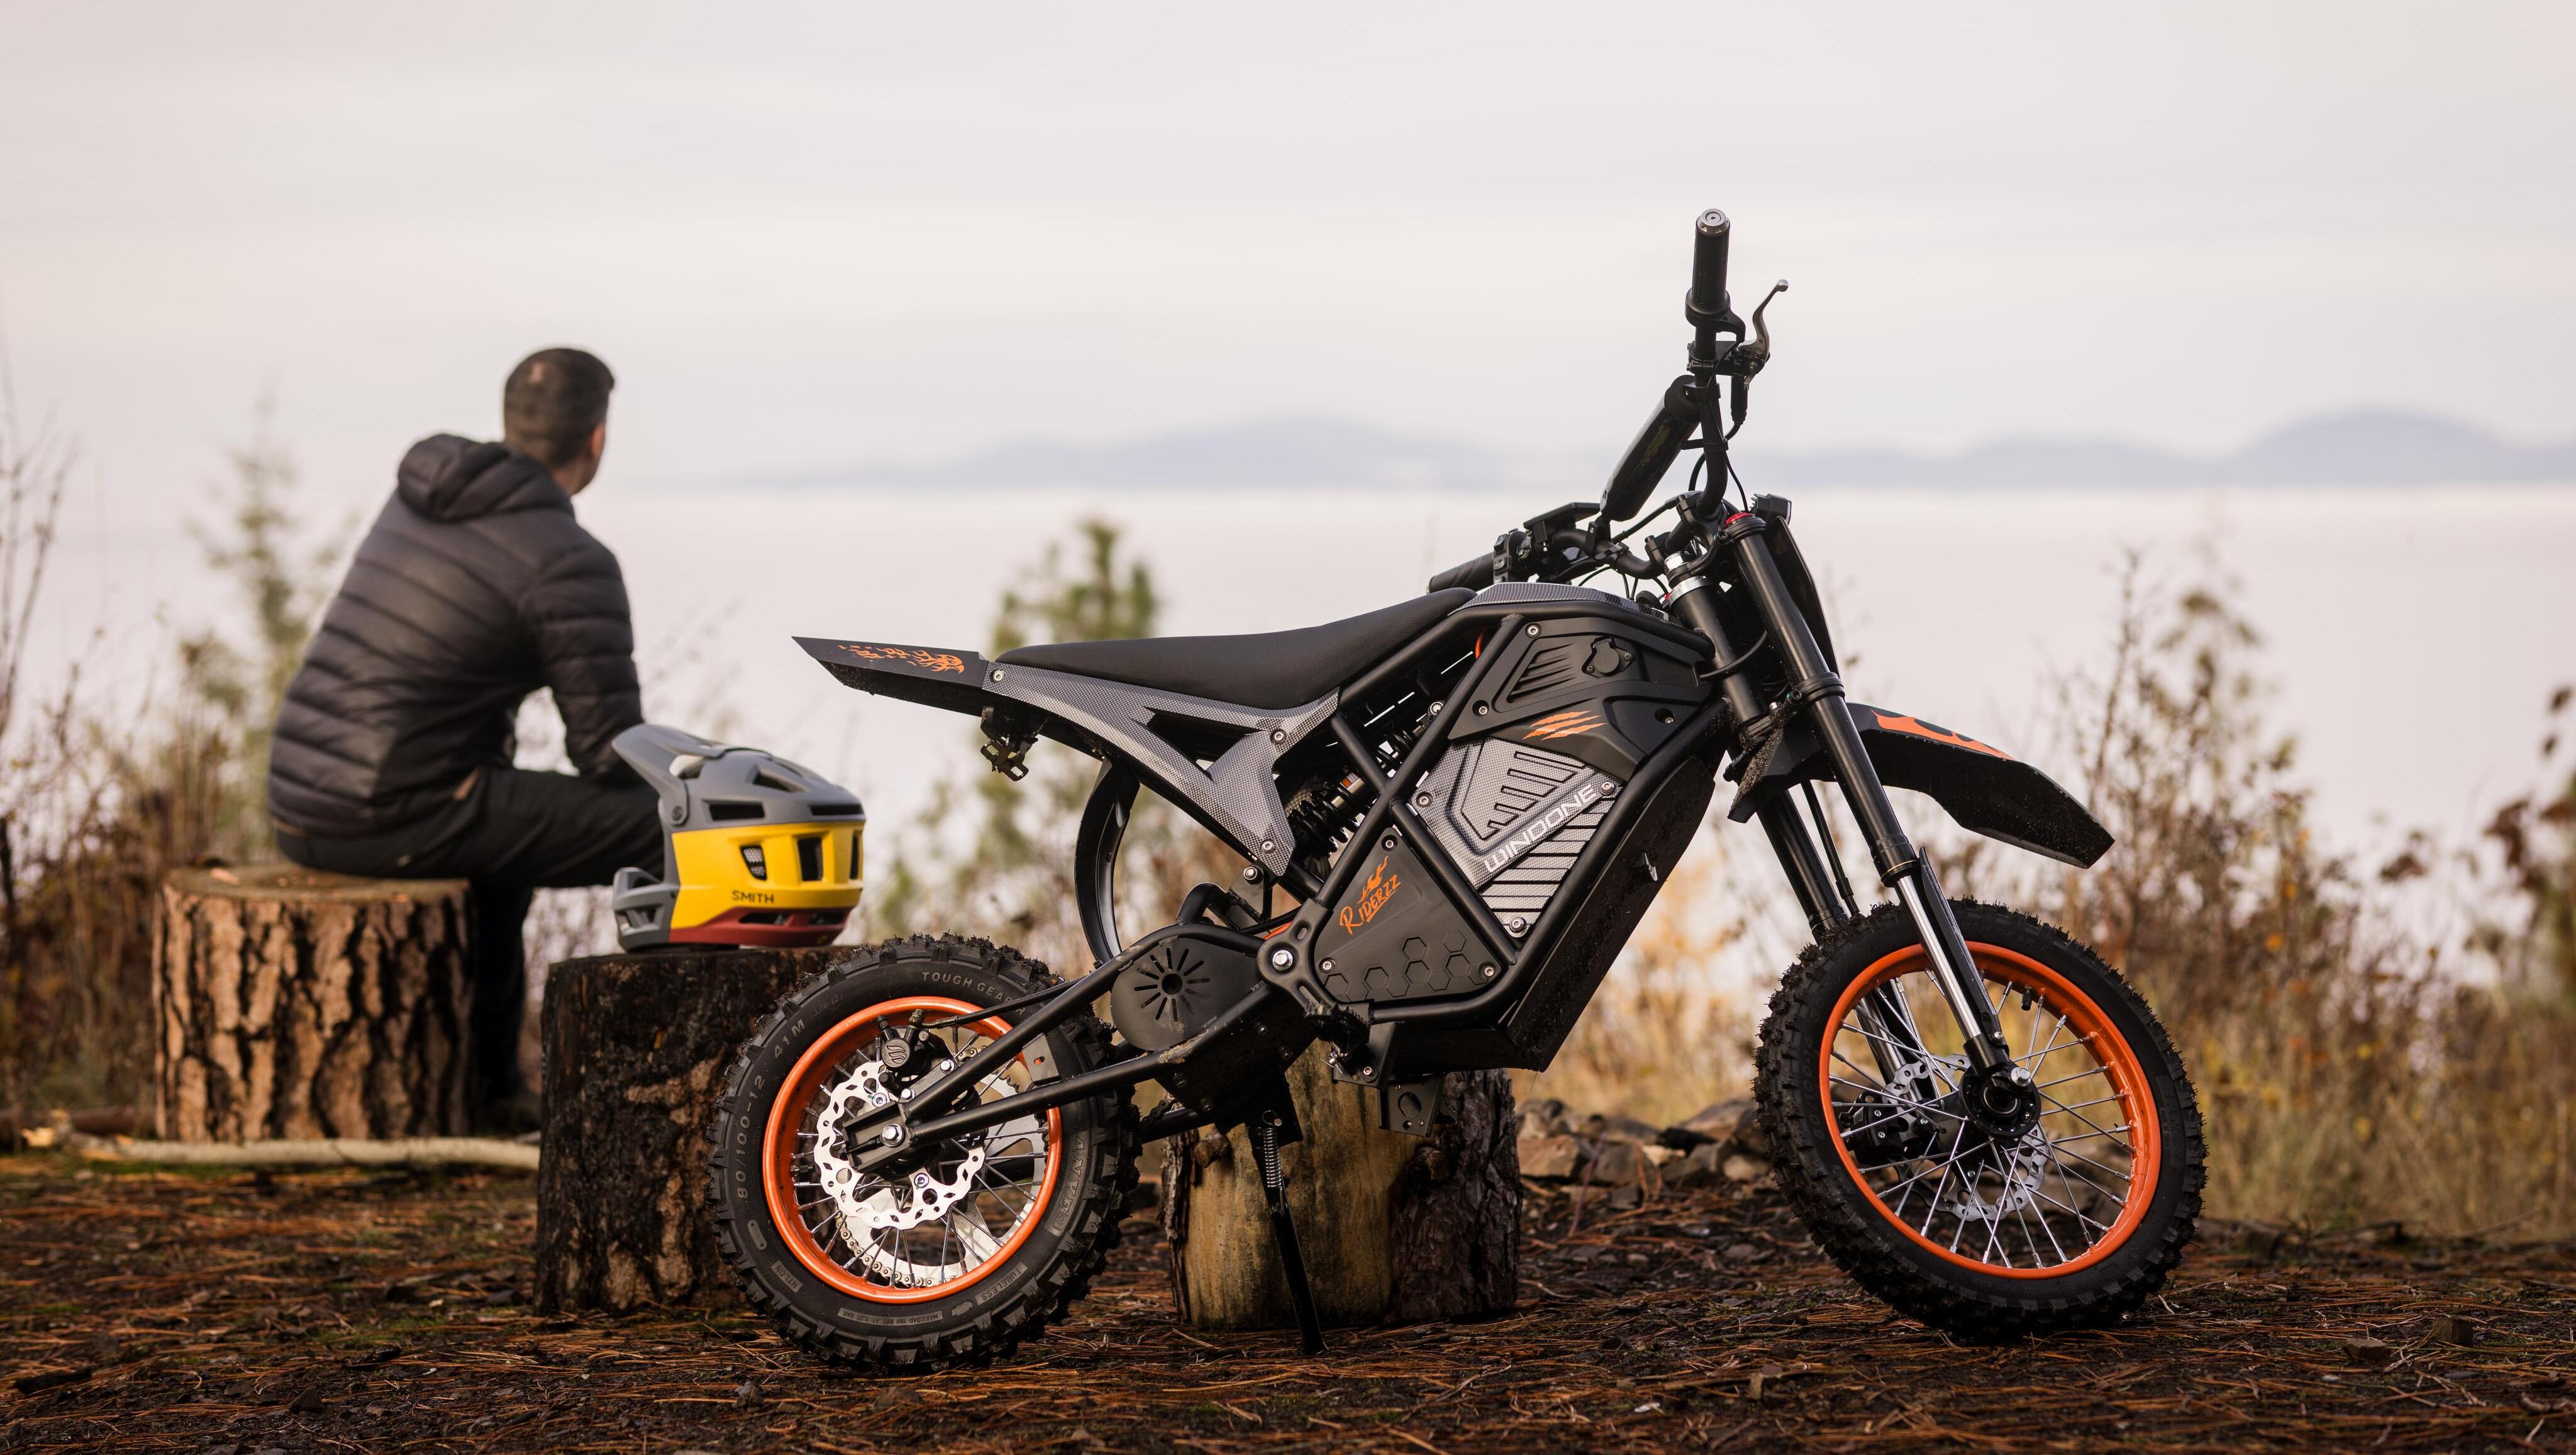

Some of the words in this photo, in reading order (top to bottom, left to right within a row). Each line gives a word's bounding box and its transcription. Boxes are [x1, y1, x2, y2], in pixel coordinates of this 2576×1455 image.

[1485, 784, 1596, 872] WINDONE
[731, 889, 774, 903] SMITH
[922, 972, 973, 988] TOUGH
[735, 1074, 765, 1200] 80/100-12
[774, 1265, 799, 1289] NYLON
[981, 1268, 1022, 1301] TUBELESS
